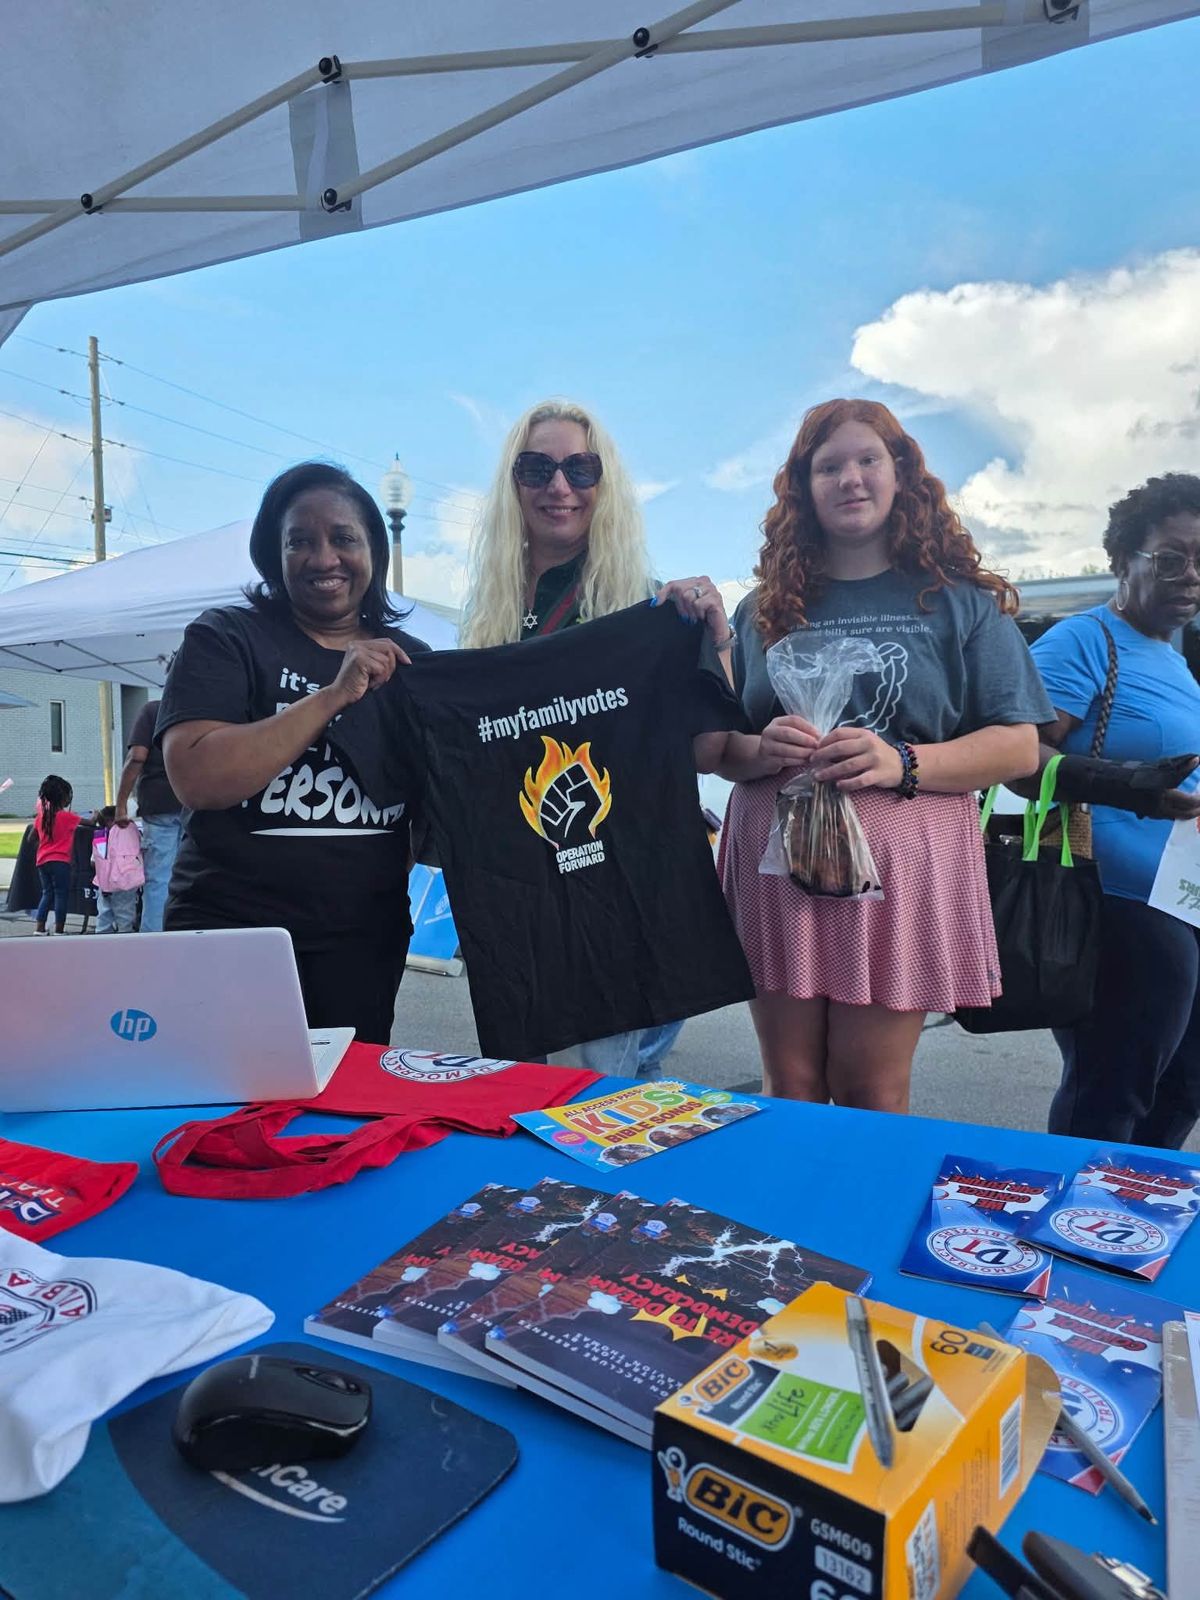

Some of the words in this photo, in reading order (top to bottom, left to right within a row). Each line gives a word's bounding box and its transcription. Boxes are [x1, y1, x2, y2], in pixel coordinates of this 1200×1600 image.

[838, 616, 878, 626] invisible
[850, 626, 872, 636] sure
[876, 625, 893, 633] are
[280, 668, 320, 695] it's
[478, 687, 629, 743] #myfamilyvotes
[556, 840, 604, 864] OPERATION
[558, 851, 606, 875] FORWARD
[117, 1009, 152, 1042] hp
[385, 1056, 493, 1080] DEMOCRACY
[563, 1108, 583, 1119] ALL
[581, 1098, 615, 1113] ACCESS
[570, 1089, 688, 1137] KIDS
[604, 1120, 654, 1144] BIBLE
[651, 1101, 705, 1124] SONGS
[1058, 1223, 1147, 1252] DEMOCRACY
[1075, 1220, 1136, 1245] DT
[467, 1248, 528, 1272] REAM
[935, 1246, 1028, 1274] DEMOCRACY
[952, 1239, 1011, 1265] DT
[587, 1275, 666, 1317] DREAM
[621, 1273, 760, 1336] DEMOCRACY
[518, 1320, 579, 1352] PRESENTS
[669, 1312, 698, 1333] TO
[930, 1330, 968, 1355] 60
[583, 1352, 643, 1384] MCCLURE
[678, 1517, 724, 1553] Round
[810, 1518, 872, 1561] GSM609
